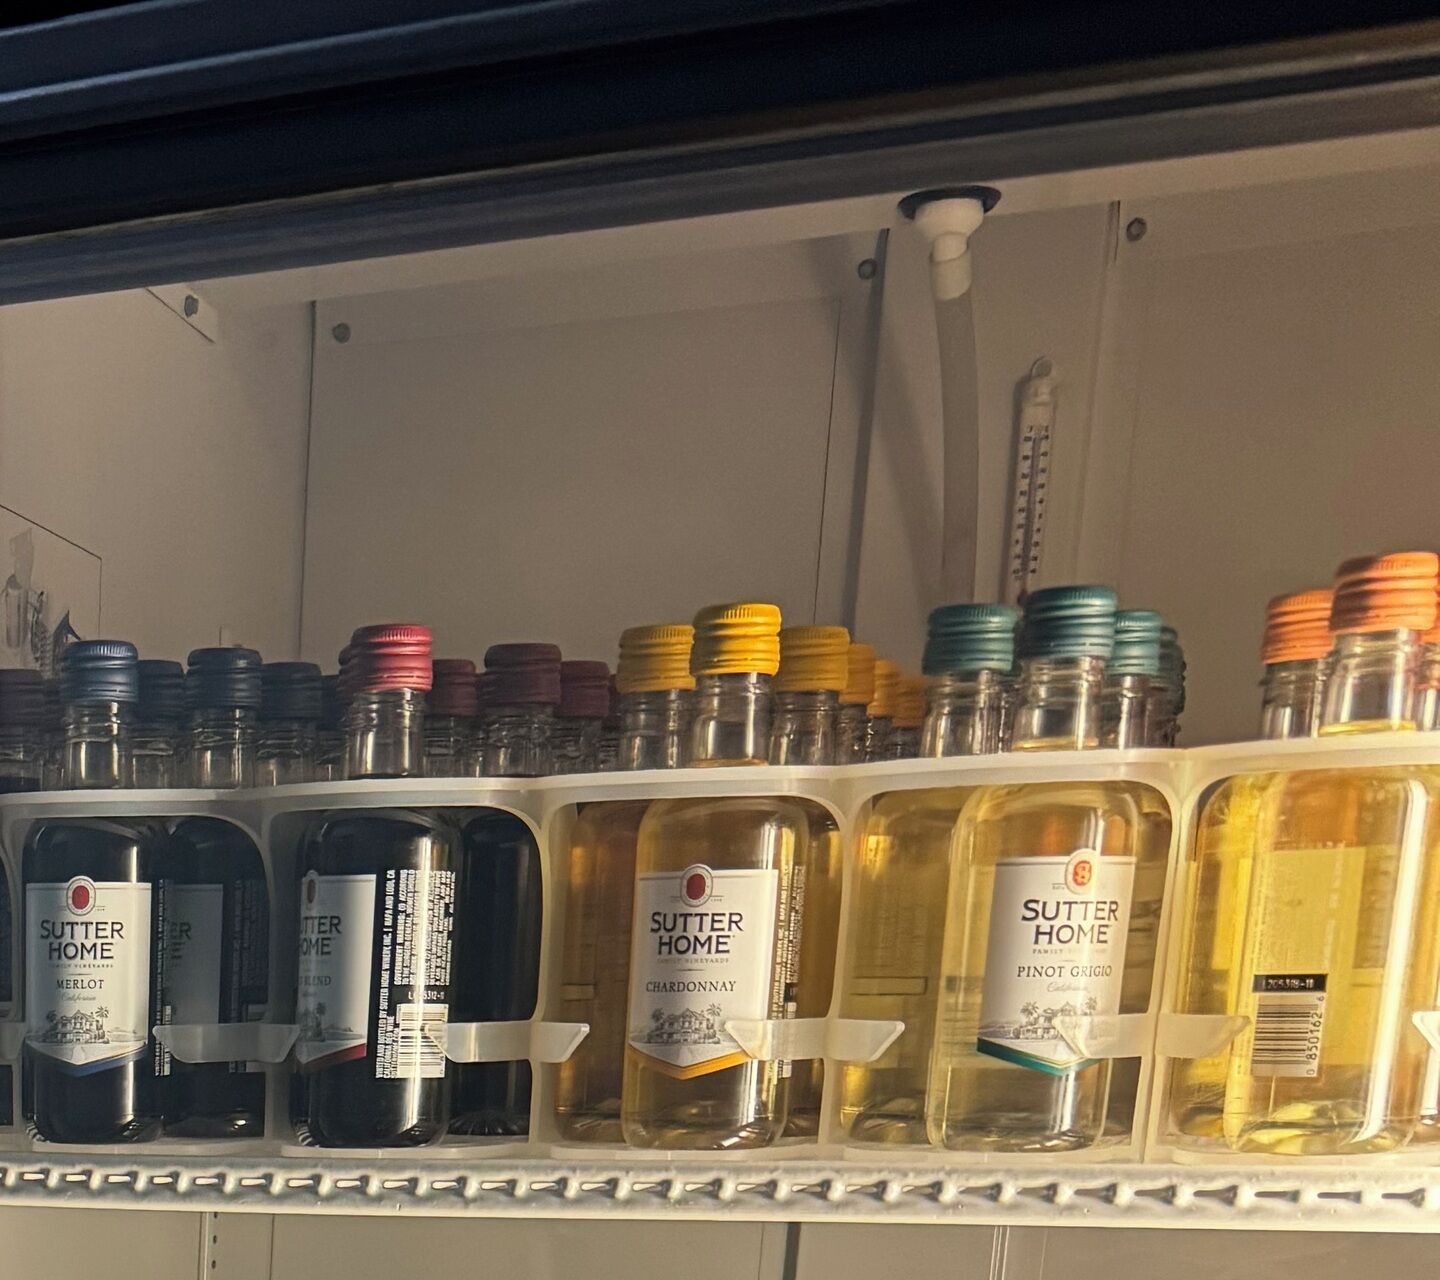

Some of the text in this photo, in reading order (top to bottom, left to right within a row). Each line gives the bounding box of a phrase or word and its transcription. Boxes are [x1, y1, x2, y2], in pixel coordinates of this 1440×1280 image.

[1021, 898, 1119, 922] SUTTER
[40, 920, 125, 940] SUTTER
[650, 911, 743, 933] SUTTER
[1033, 923, 1109, 945] HOME
[48, 941, 115, 961] HOME
[658, 935, 731, 955] HOME
[1017, 965, 1112, 978] PINOT GRIGIO
[56, 978, 104, 989] MERLOT
[646, 980, 737, 993] CHARDONNAY
[1307, 1011, 1323, 1061] 850162
